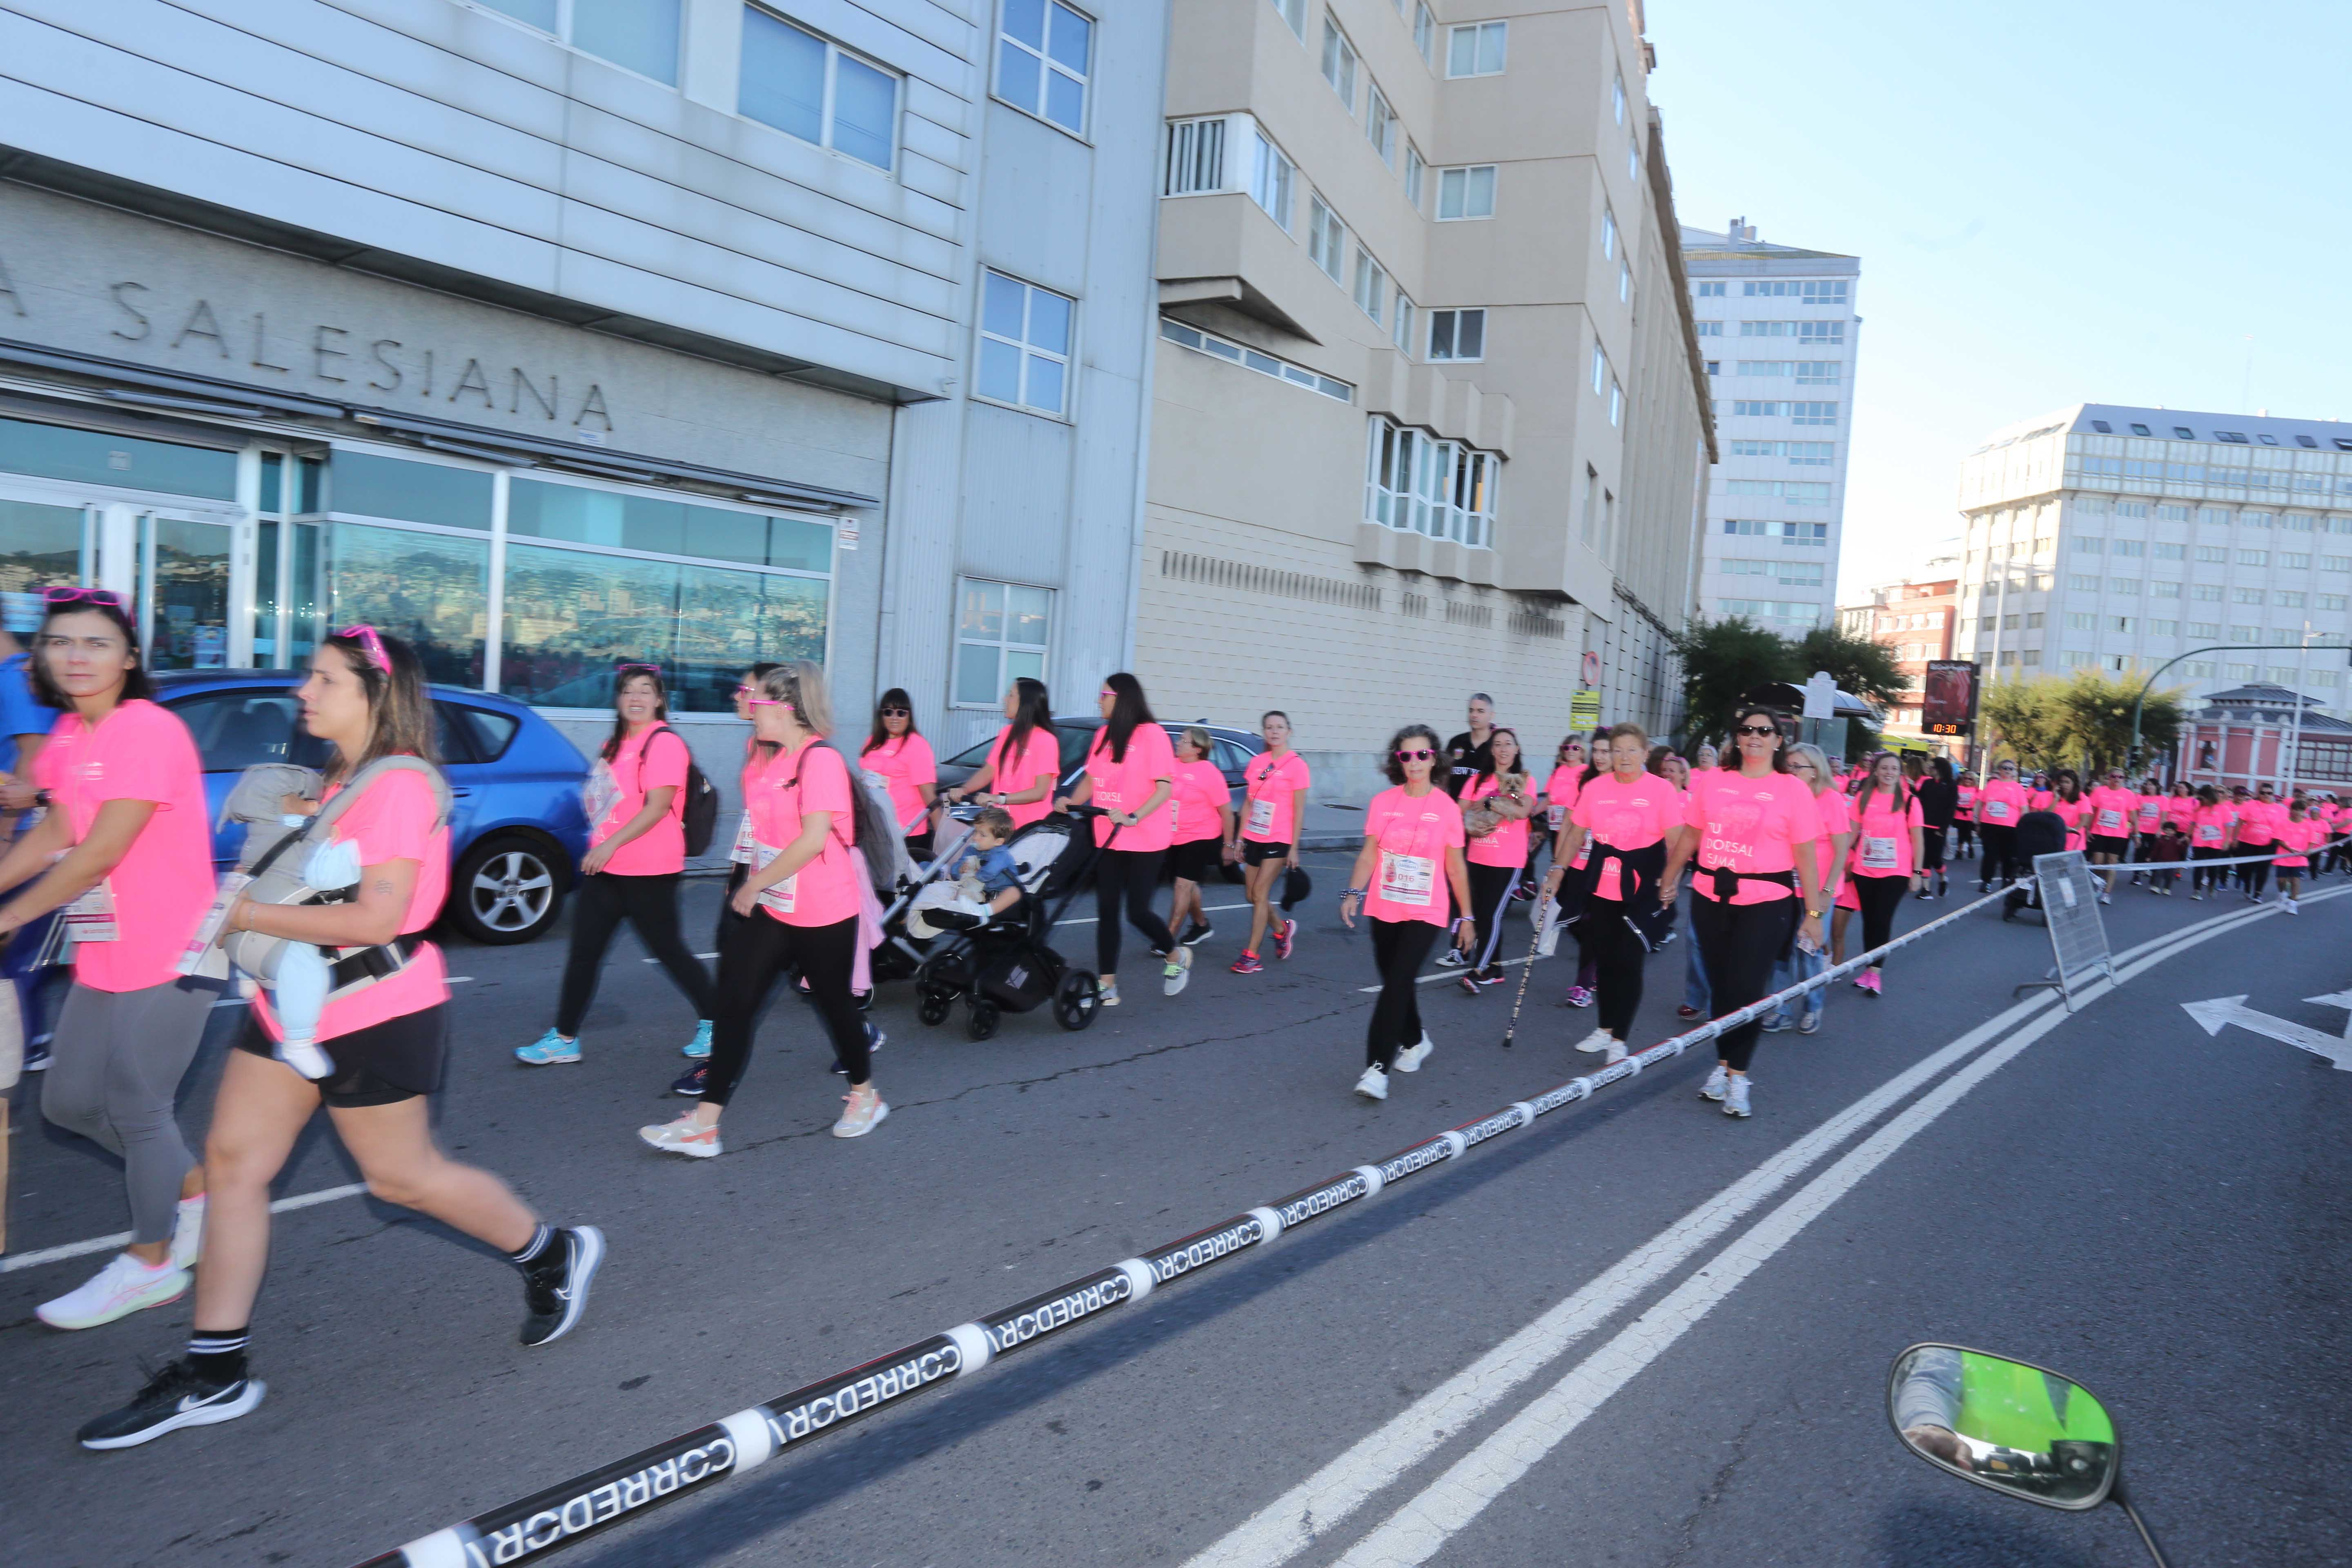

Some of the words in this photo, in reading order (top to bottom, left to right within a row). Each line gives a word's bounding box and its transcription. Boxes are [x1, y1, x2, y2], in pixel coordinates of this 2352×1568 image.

[110, 281, 614, 432] SALESIANA
[1933, 724, 1957, 734] 10:30
[1708, 822, 1722, 834] TU
[1706, 838, 1753, 857] DORSAL
